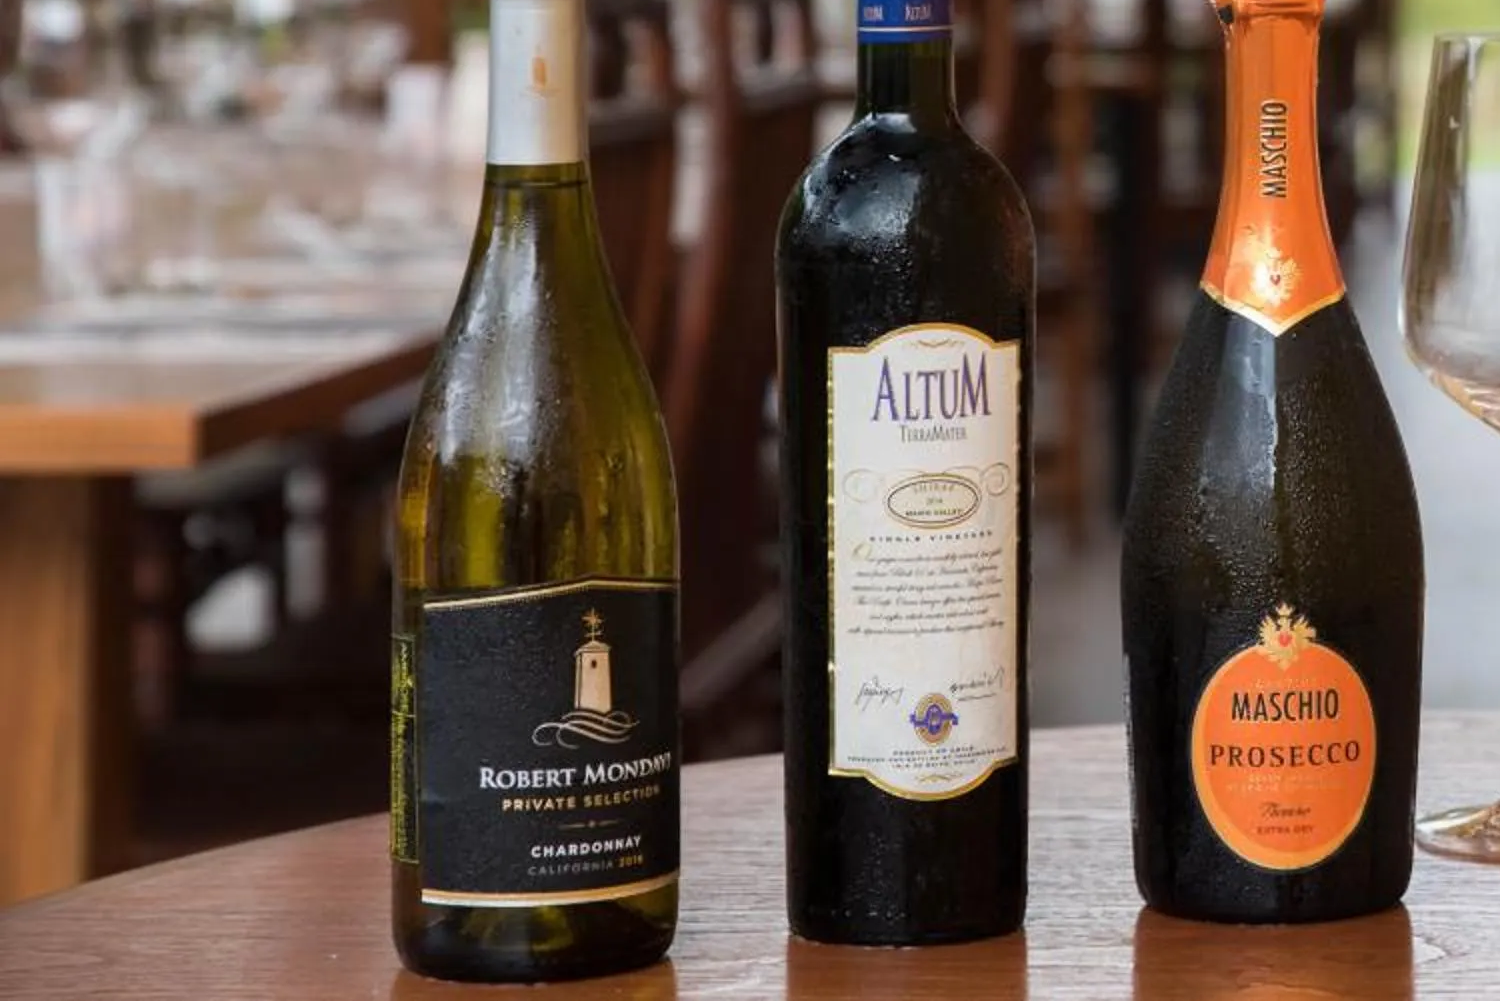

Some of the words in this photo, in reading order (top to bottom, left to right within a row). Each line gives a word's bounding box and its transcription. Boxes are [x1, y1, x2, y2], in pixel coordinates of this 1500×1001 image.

[1261, 100, 1288, 199] MASCHIO
[870, 351, 992, 422] ALTUM
[1230, 688, 1340, 722] MASCHIO
[1209, 740, 1361, 768] PROSECCO
[479, 766, 577, 789] ROBERT
[583, 751, 672, 786] MONDAVI
[502, 796, 577, 812] PRIVATE
[583, 785, 661, 808] SELECTION
[530, 834, 642, 858] CHARDONNAY
[527, 859, 614, 877] CALIFORNIA
